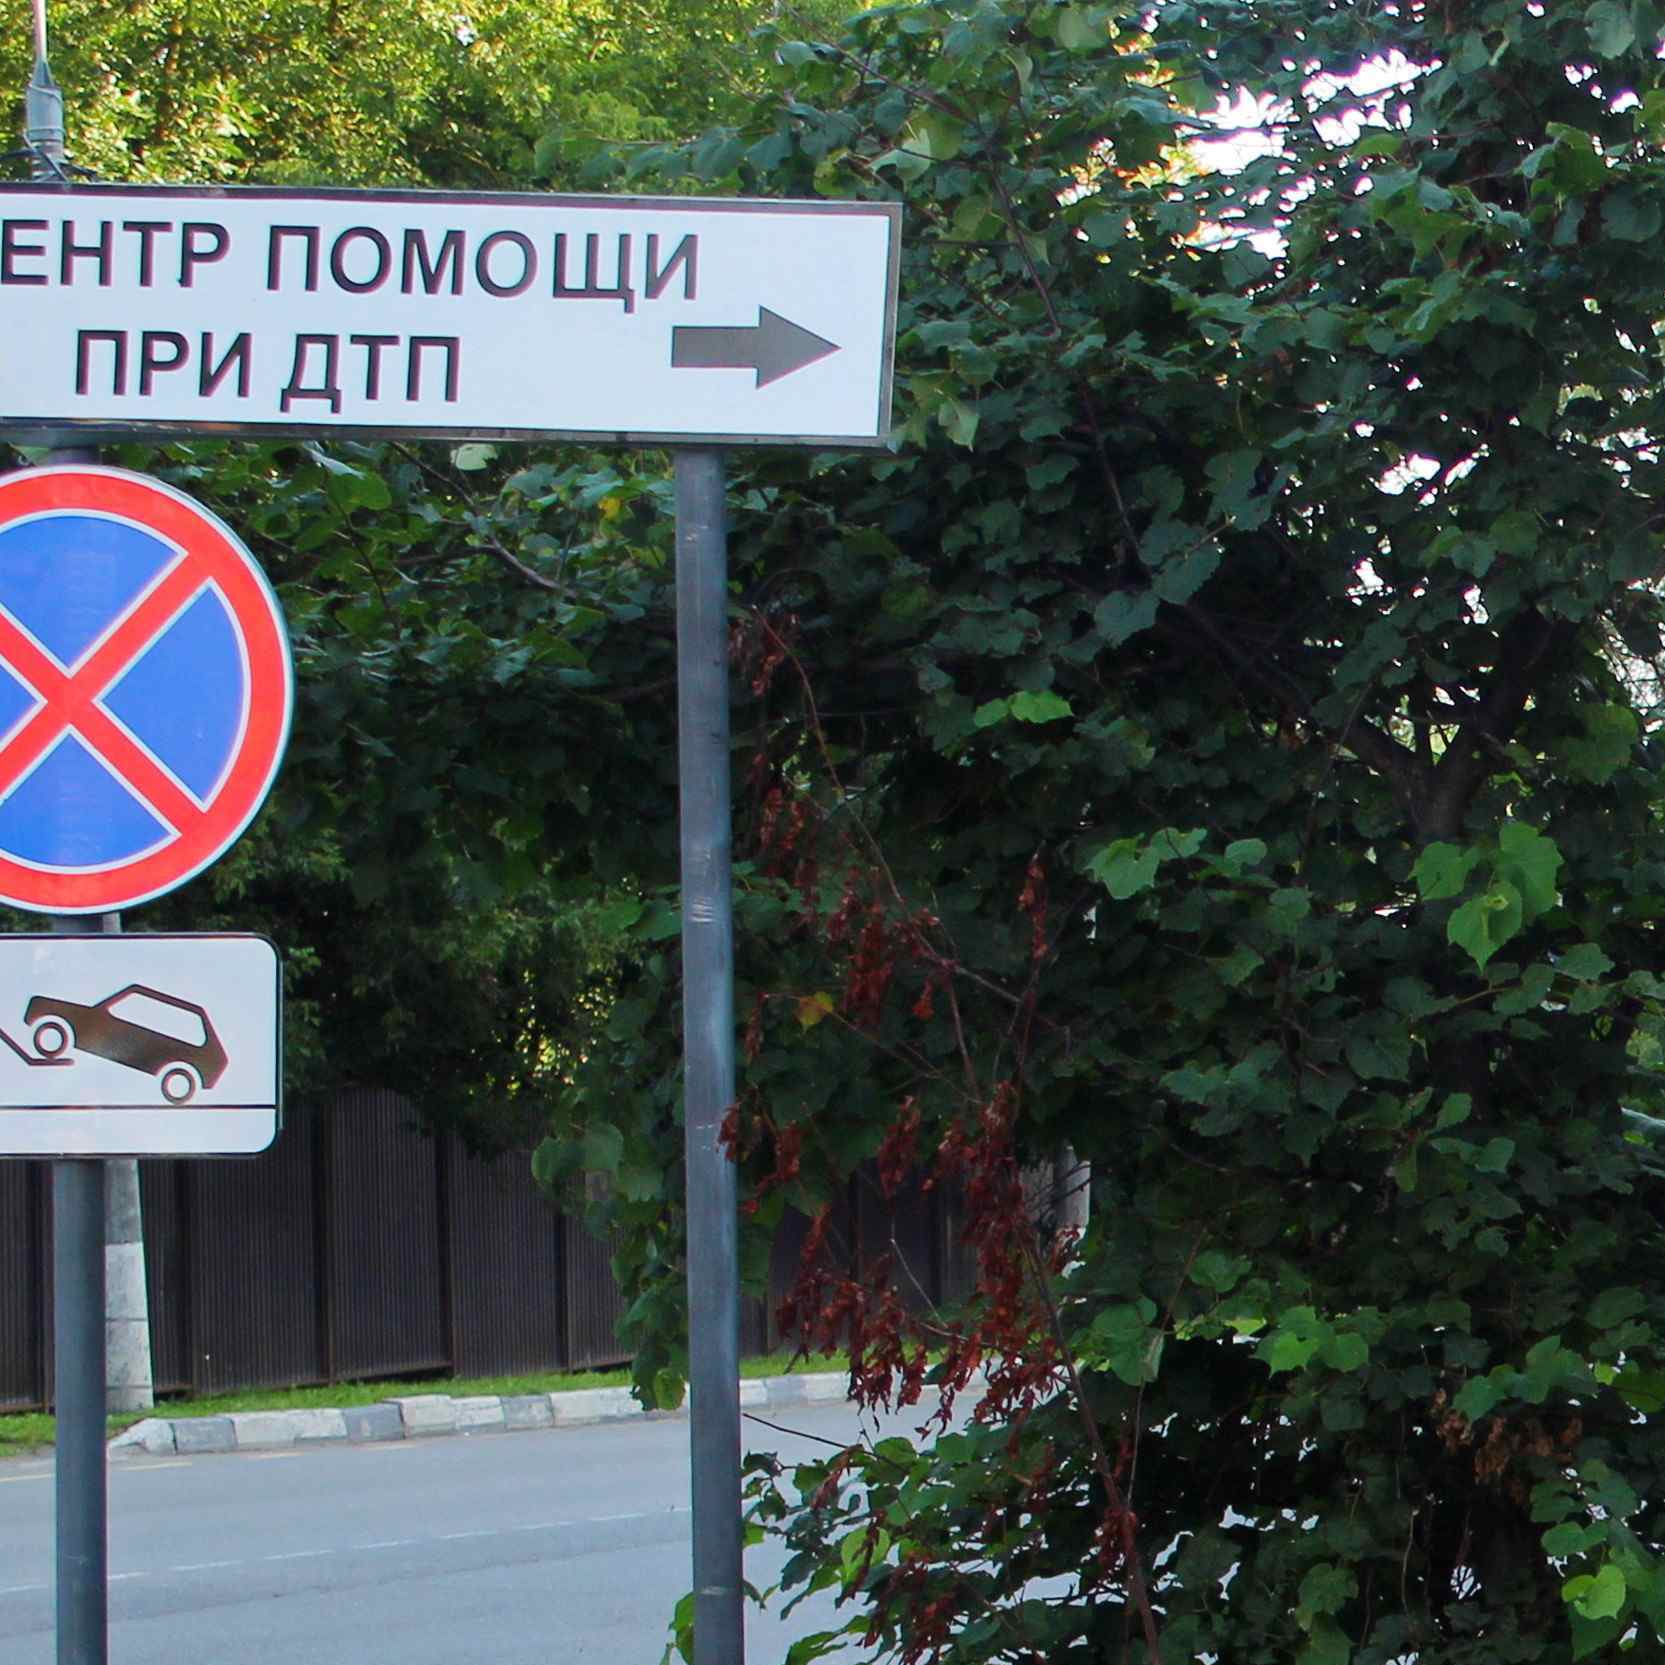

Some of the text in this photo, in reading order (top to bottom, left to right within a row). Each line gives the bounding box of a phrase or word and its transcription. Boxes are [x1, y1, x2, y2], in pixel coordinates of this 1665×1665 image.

[267, 225, 699, 314] ПОМОЩИ
[74, 328, 462, 415] ПРИ ДТП
